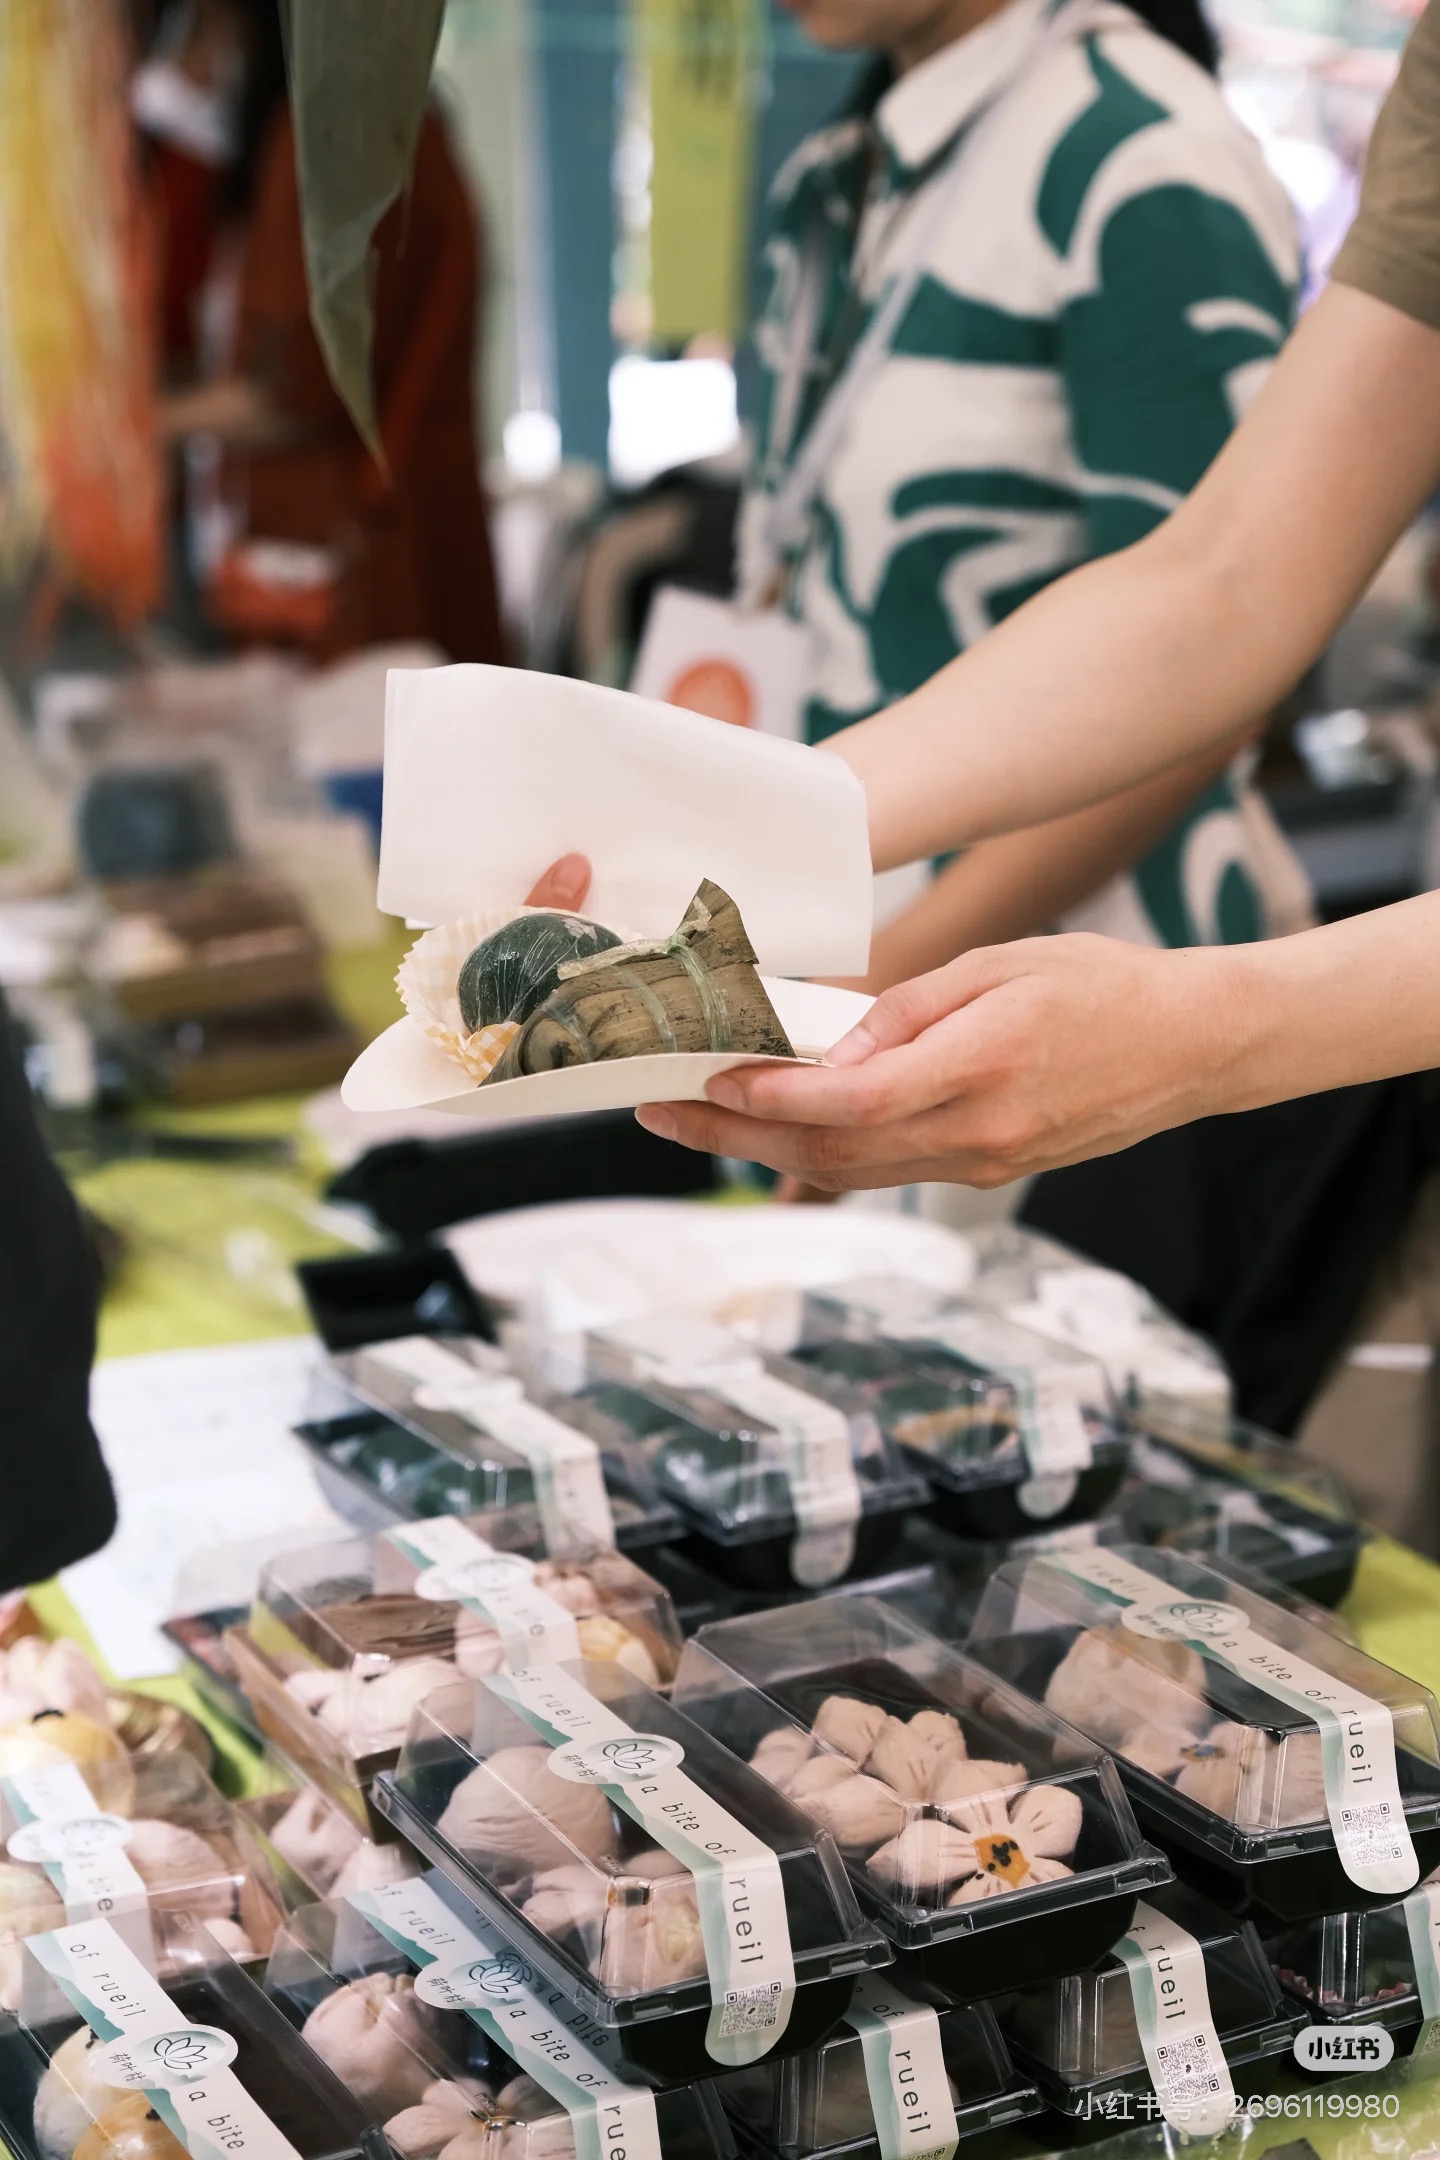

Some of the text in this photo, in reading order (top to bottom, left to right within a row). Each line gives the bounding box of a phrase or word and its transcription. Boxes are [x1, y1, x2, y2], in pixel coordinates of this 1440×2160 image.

[538, 1694, 591, 1728] rueil
[1248, 1656, 1292, 1681] bite
[1305, 1690, 1337, 1702] of
[1340, 1709, 1373, 1784] rueil
[641, 1784, 764, 1963] a bite of rueil
[399, 1910, 456, 1945] rueil
[70, 1944, 146, 2018] of rueil
[1148, 1945, 1186, 2019] rueil
[108, 2052, 147, 2083] 荷叶村
[509, 2009, 528, 2019] a
[531, 2030, 570, 2061] bite
[576, 2073, 608, 2087] of
[873, 2004, 931, 2133] of rueil
[189, 2091, 245, 2150] a bite
